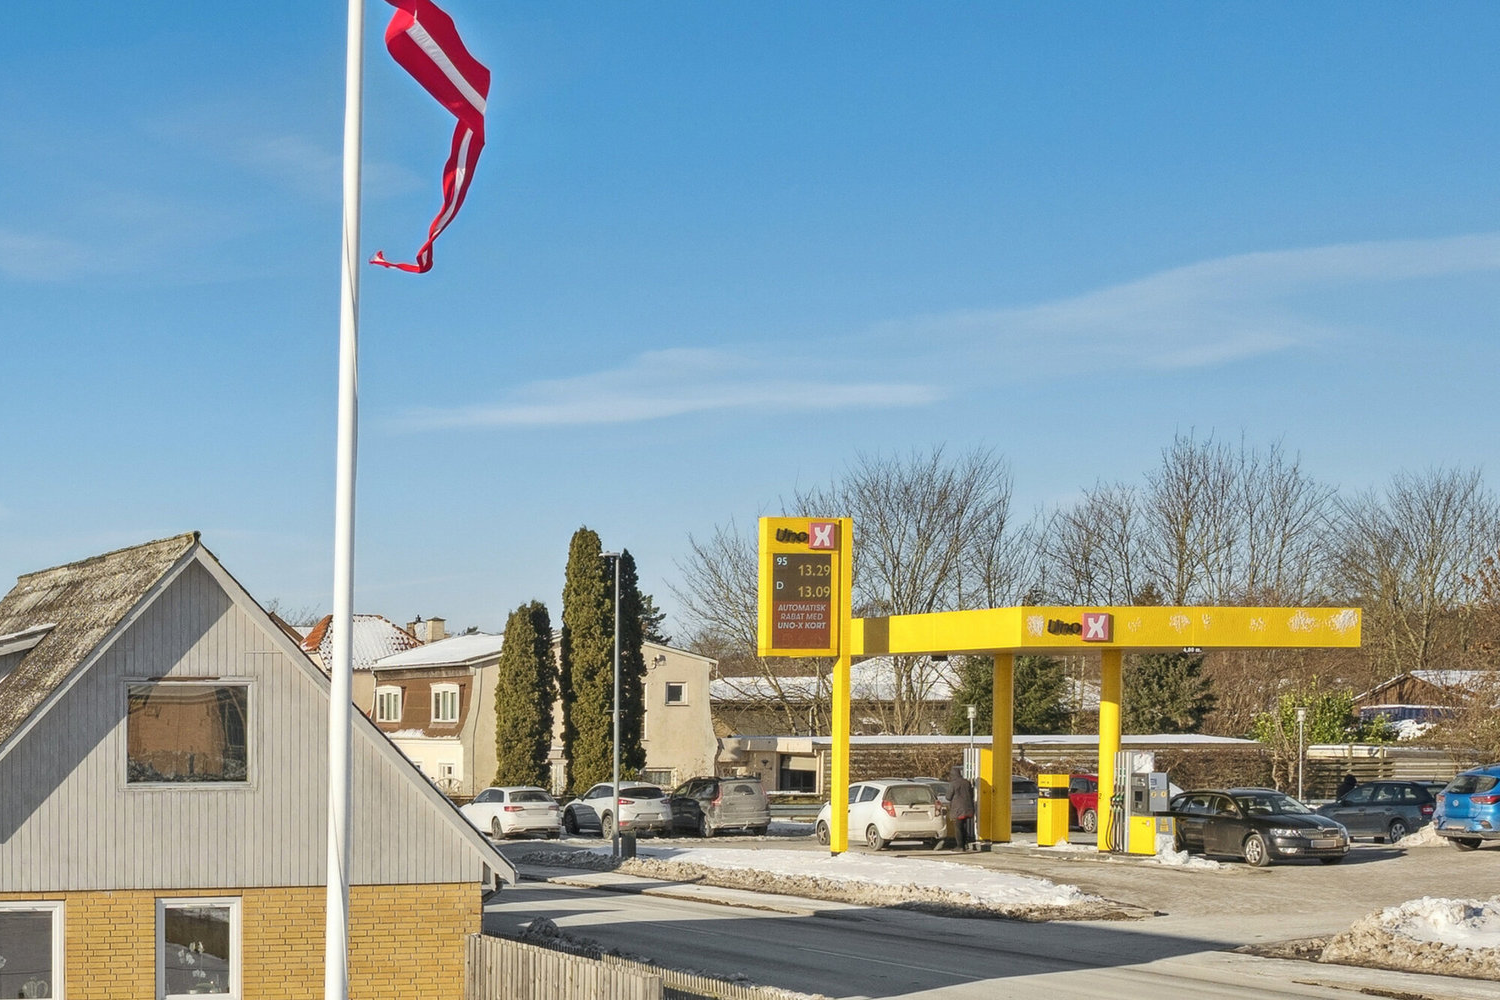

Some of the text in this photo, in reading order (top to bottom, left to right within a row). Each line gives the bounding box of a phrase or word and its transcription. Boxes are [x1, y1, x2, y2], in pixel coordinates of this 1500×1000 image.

[776, 525, 831, 546] Uno X
[776, 557, 787, 565] 95
[798, 565, 830, 576] 13.29
[776, 581, 784, 590] D
[798, 586, 830, 598] 13.09
[778, 604, 826, 612] AUTOMATISK
[1047, 615, 1106, 638] Uno X
